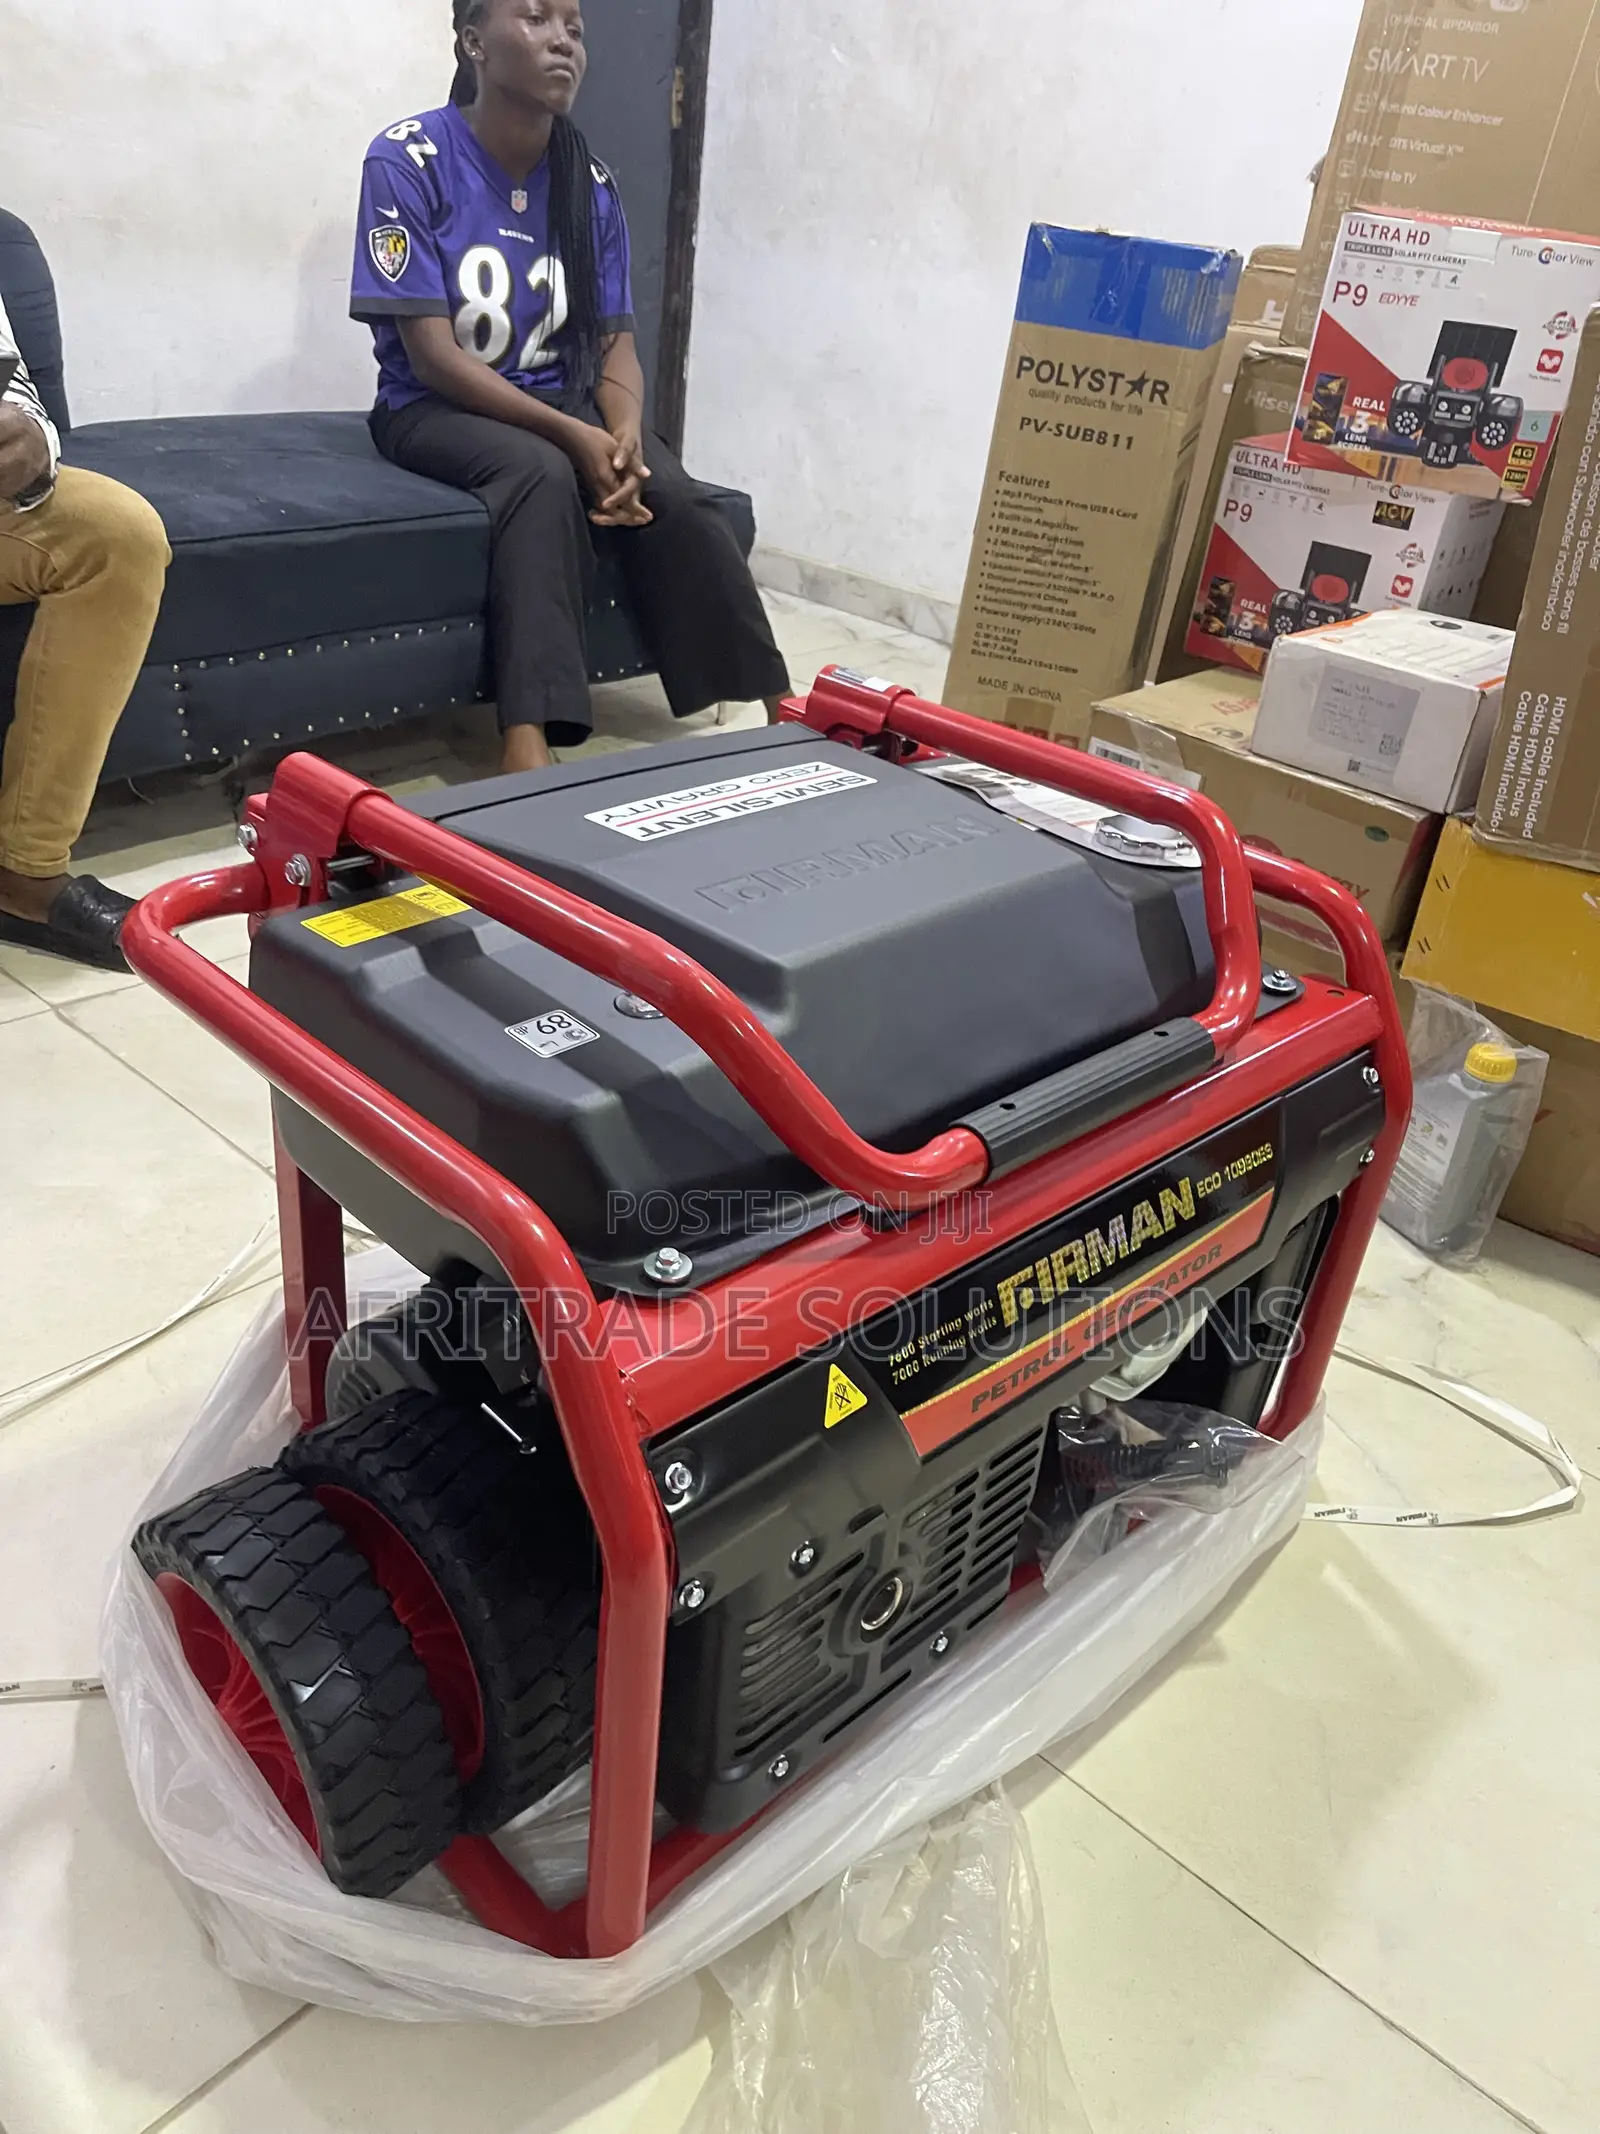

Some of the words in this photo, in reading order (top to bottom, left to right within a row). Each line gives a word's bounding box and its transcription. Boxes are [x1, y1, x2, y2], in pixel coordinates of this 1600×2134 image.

[1364, 46, 1458, 80] SMART
[1462, 56, 1490, 83] TV
[1418, 104, 1452, 119] Colour
[1452, 109, 1504, 126] Enhancer
[1404, 173, 1417, 184] TV
[1348, 221, 1401, 243] ULTRA
[1406, 229, 1430, 245] HD
[1432, 255, 1467, 266] CAMERAS
[1570, 253, 1595, 267] View
[454, 244, 568, 370] 82
[1332, 280, 1368, 307] P9
[1379, 292, 1420, 306] EDYYE
[1028, 387, 1061, 403] quality
[1064, 393, 1107, 410] products
[1110, 400, 1125, 412] for
[1128, 402, 1143, 416] life
[1352, 396, 1386, 412] REAL
[1019, 416, 1134, 451] PV-SUB811
[1345, 432, 1367, 443] LENS
[1236, 451, 1278, 471] ULTRA
[1282, 461, 1301, 475] HD
[1514, 447, 1533, 458] 4G
[1579, 445, 1592, 473] con
[998, 470, 1050, 489] Features
[1024, 492, 1063, 506] Playback
[1065, 500, 1088, 511] From
[1116, 508, 1138, 520] Card
[1224, 499, 1253, 523] P9
[1561, 475, 1587, 550] Subwoofer
[1041, 533, 1084, 548] Function
[1580, 519, 1593, 538] de
[1568, 540, 1589, 587] basses
[1240, 599, 1267, 613] REAL
[1560, 588, 1575, 620] sans
[977, 675, 1008, 691] MADE
[1013, 683, 1024, 694] IN
[1028, 686, 1062, 702] CHINA
[1512, 691, 1532, 733] Cable
[1548, 696, 1567, 735] HDMI
[1503, 734, 1522, 772] HDMI
[1520, 738, 1539, 776] HDMI
[1537, 737, 1555, 776] cable
[747, 763, 832, 785] ZERO
[603, 782, 742, 823] GRAVITY
[640, 775, 869, 839] SEMI-SILENT
[1510, 776, 1531, 818] inclus
[1522, 778, 1548, 839] included
[1197, 1171, 1222, 1199] ECO
[996, 1176, 1196, 1327] FIRMAN
[917, 1317, 962, 1350] Starting
[964, 1298, 994, 1322] watts
[970, 1338, 1076, 1415] PETROL
[1082, 1243, 1223, 1342] GENERATOR
[892, 1359, 920, 1385] 7000
[921, 1335, 966, 1367] Running
[968, 1316, 997, 1339] watts
